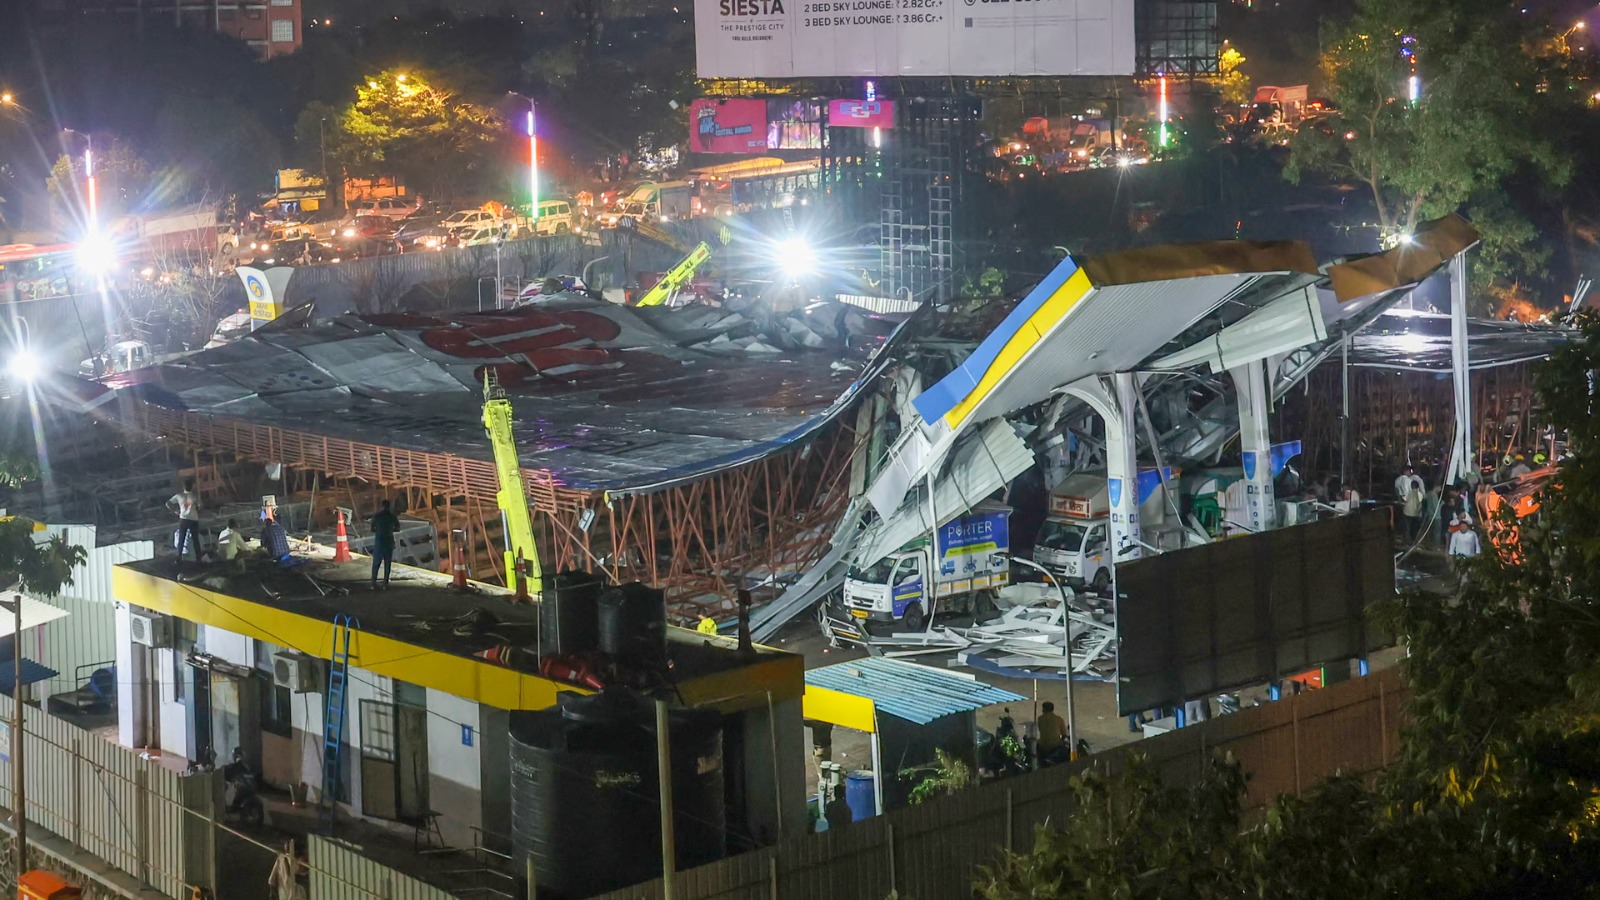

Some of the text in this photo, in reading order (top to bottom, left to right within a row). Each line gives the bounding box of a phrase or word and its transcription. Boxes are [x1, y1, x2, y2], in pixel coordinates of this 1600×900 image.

[720, 0, 784, 16] SIESTA
[803, 4, 810, 13] 2
[812, 4, 831, 12] BED
[833, 2, 850, 12] SKY
[853, 1, 894, 10] LOUNGE:
[902, 0, 923, 8] 2.82
[804, 18, 811, 27] 3
[812, 18, 832, 26] BED
[834, 17, 851, 26] SKY
[853, 15, 894, 25] LOUNGE:
[903, 14, 924, 23] 3.86
[948, 520, 993, 539] PORTER
